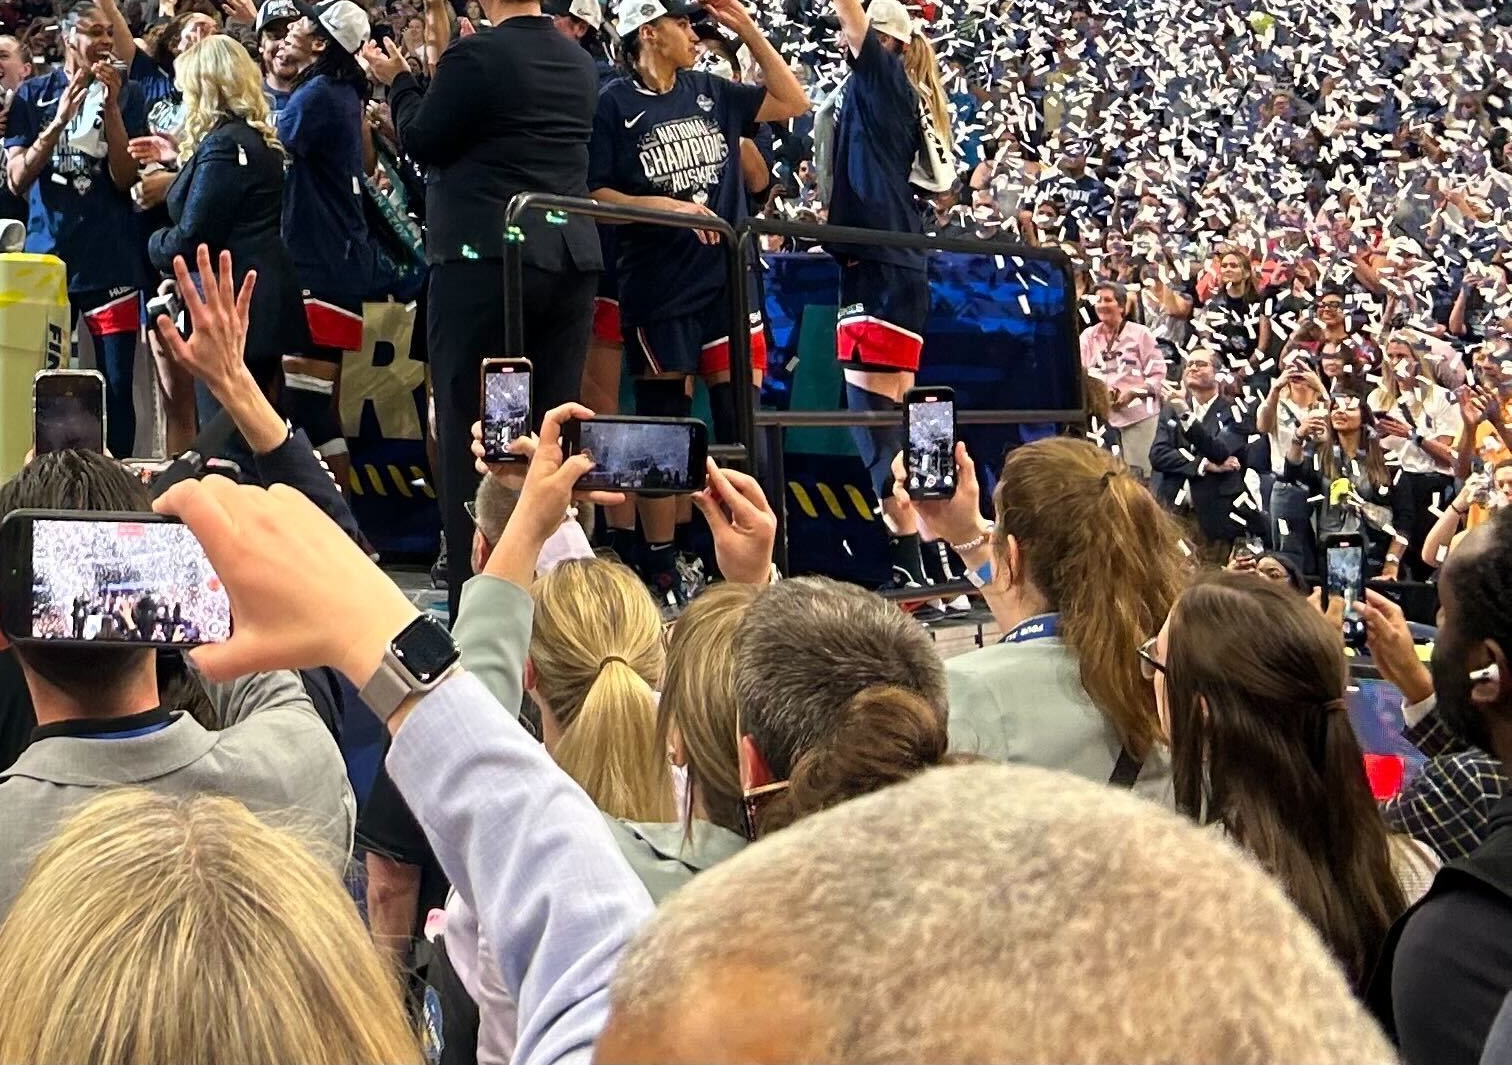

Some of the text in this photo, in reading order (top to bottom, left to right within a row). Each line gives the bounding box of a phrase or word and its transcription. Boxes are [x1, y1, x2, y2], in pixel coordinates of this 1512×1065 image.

[656, 119, 711, 145] NATIONAL
[639, 133, 729, 178] CHAMPIONS
[339, 302, 426, 440] R
